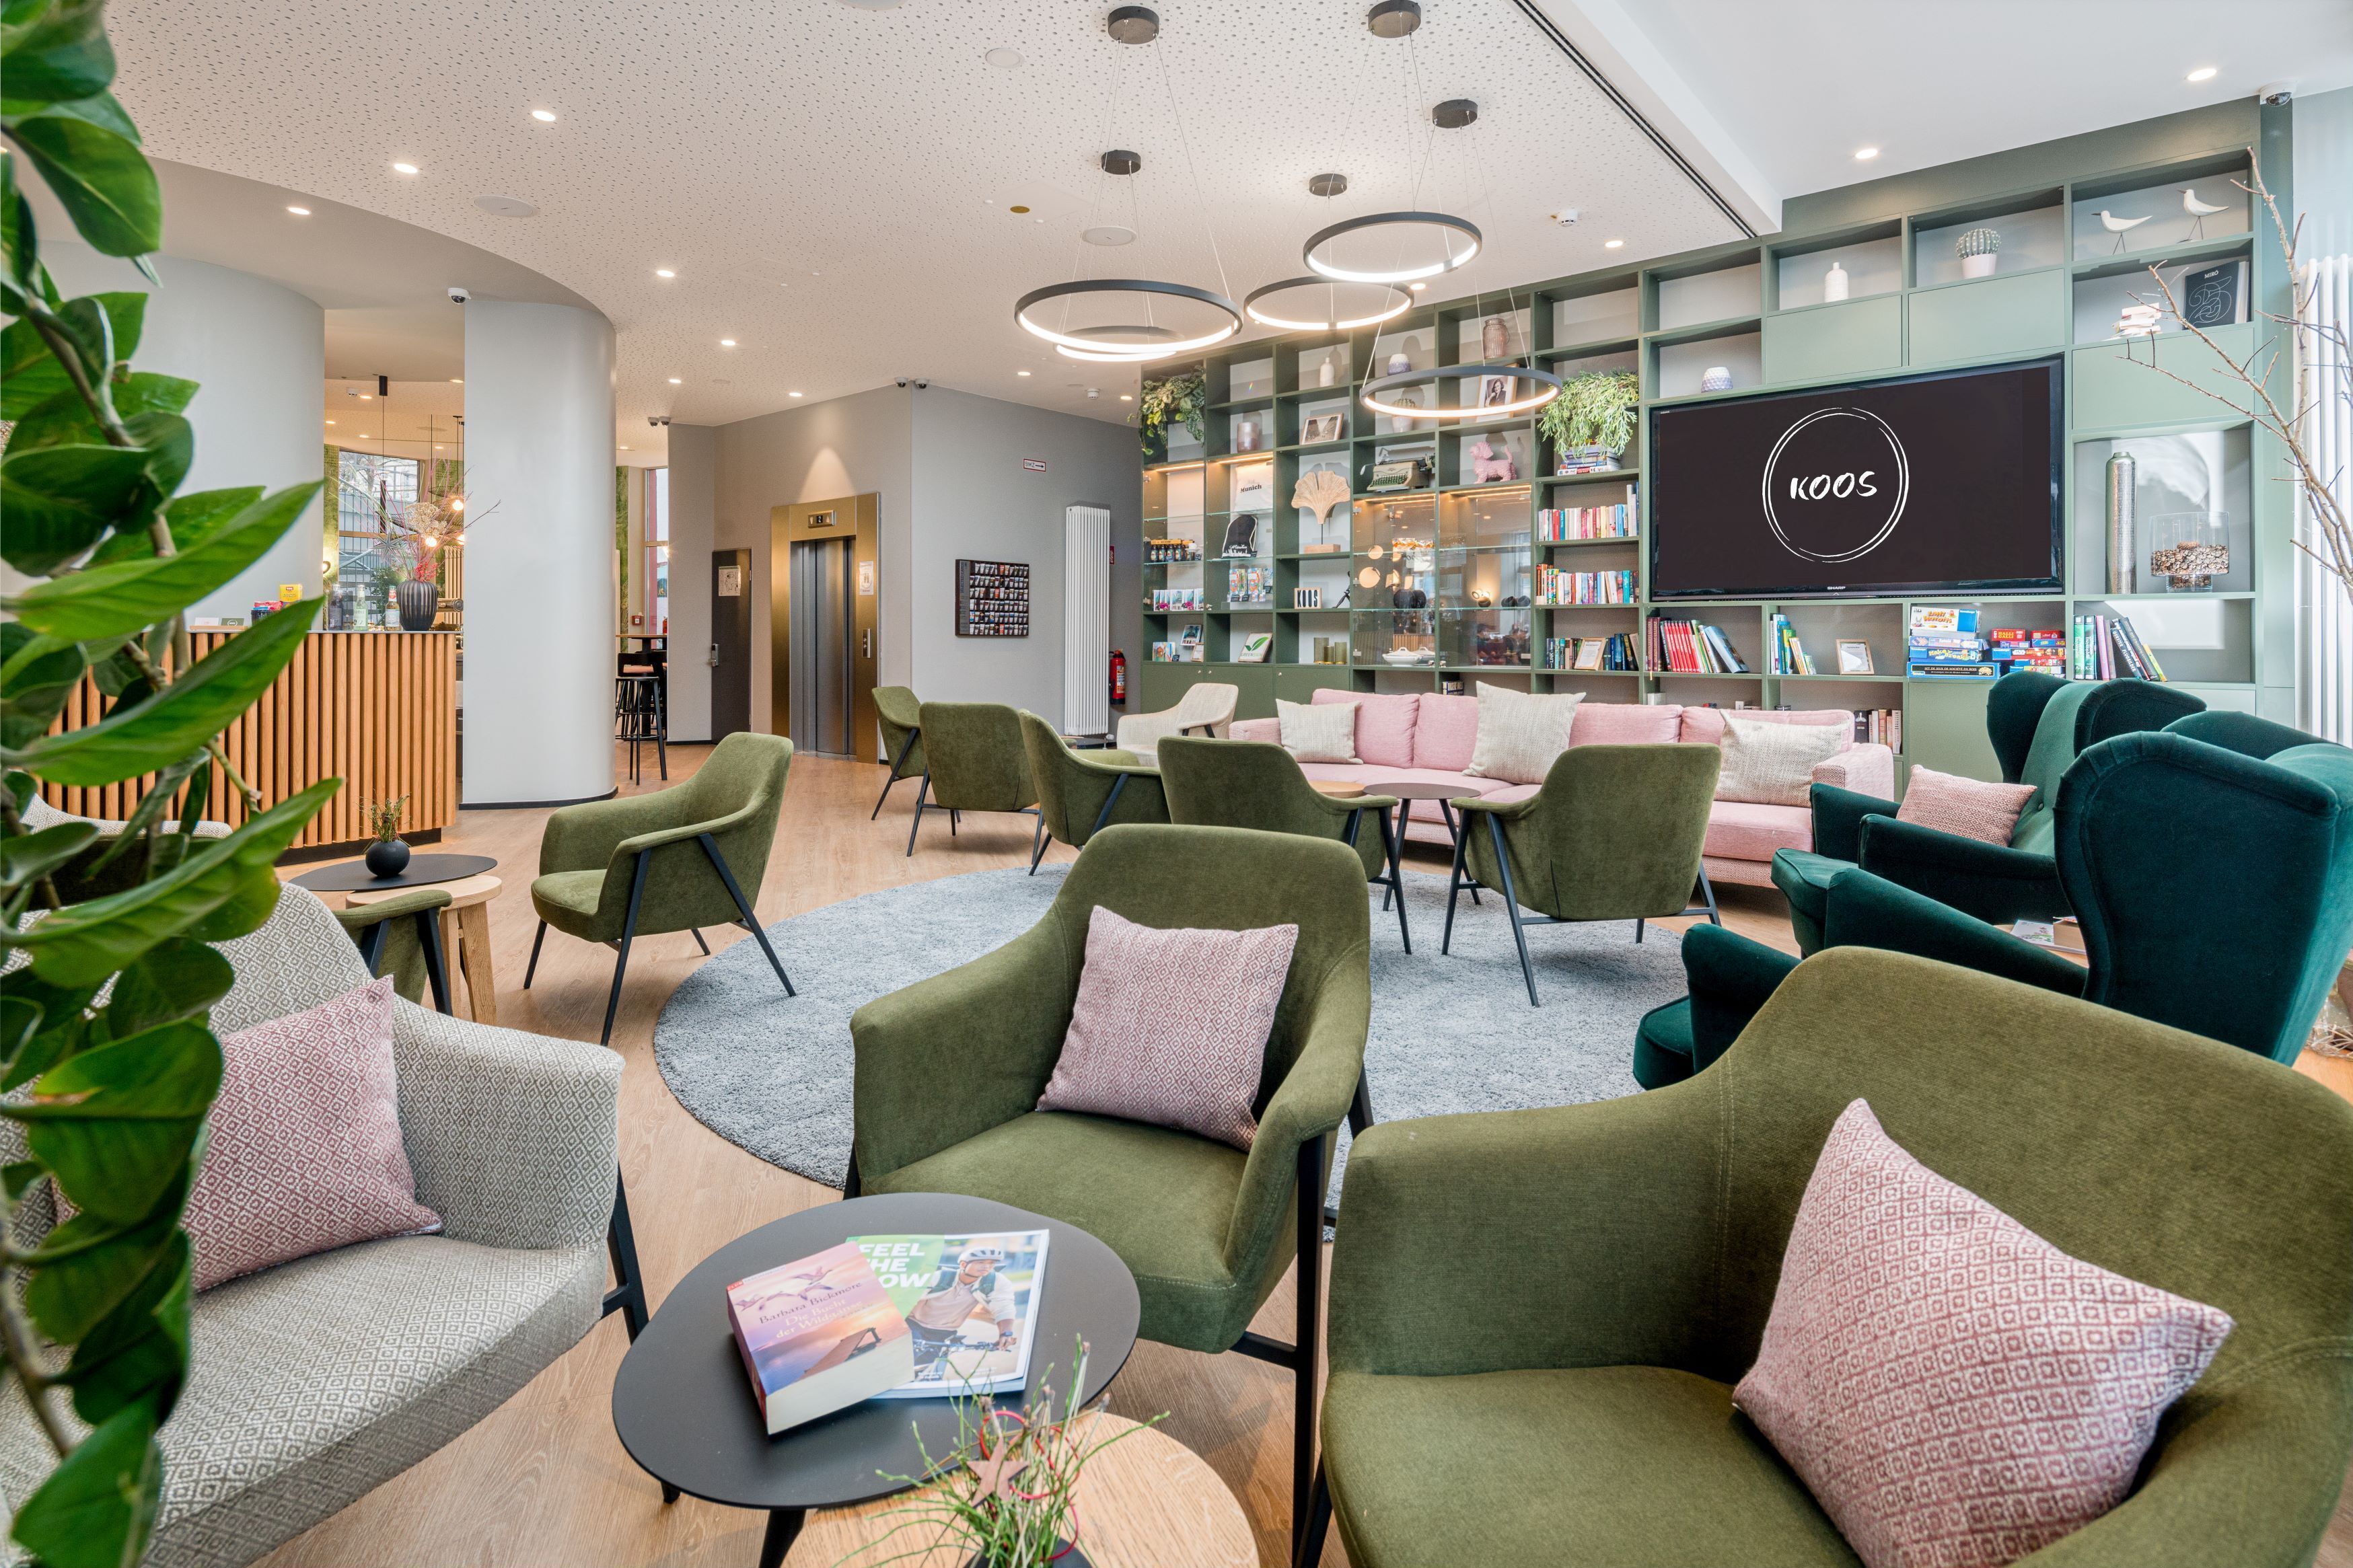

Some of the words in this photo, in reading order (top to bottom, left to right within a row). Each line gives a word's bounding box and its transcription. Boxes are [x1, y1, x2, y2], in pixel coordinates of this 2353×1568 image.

[2204, 270, 2219, 278] MIRÓ
[1240, 484, 1262, 493] Munich
[1790, 471, 1877, 500] KOOS
[1297, 589, 1318, 608] KOOS
[859, 1243, 926, 1257] FEEL
[867, 1258, 910, 1272] HE
[759, 1304, 806, 1324] Barbara
[809, 1282, 862, 1306] Bickmore
[785, 1314, 808, 1326] Die
[811, 1300, 846, 1316] Bucht
[776, 1327, 795, 1338] der
